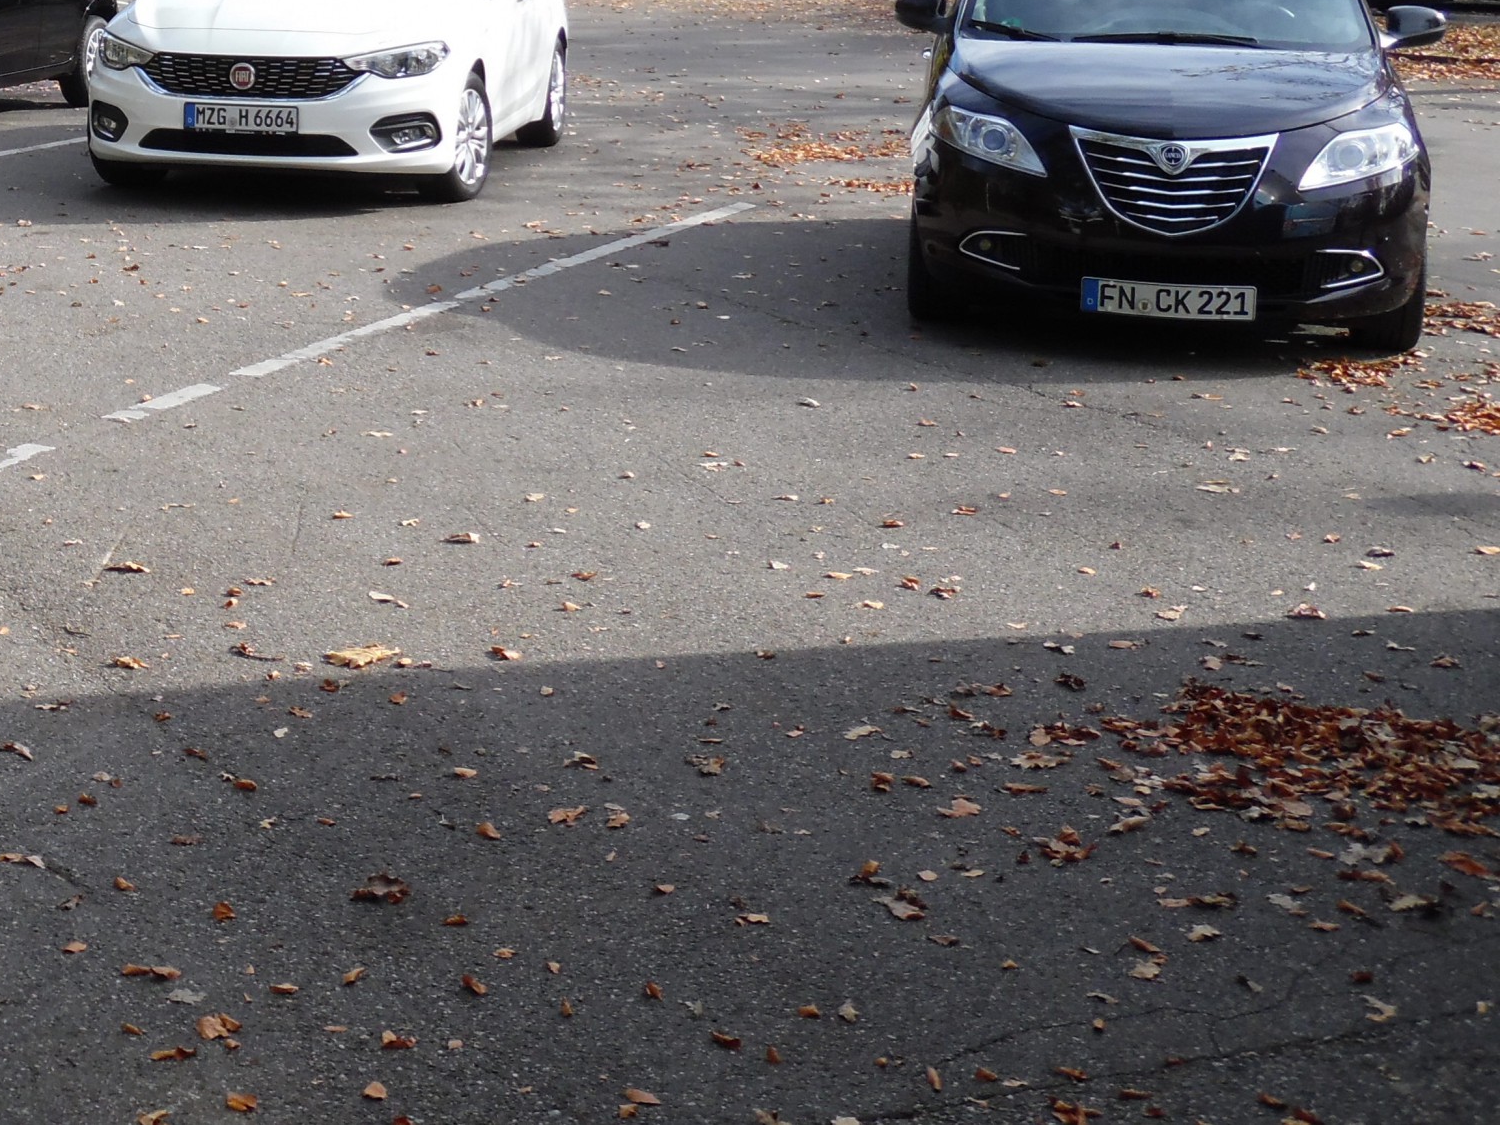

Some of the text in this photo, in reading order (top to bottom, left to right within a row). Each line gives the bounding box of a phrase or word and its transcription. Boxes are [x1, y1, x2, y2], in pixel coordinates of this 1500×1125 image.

[235, 70, 250, 83] FIAT
[196, 107, 227, 126] MZG
[238, 108, 249, 126] H
[253, 109, 295, 128] 6664
[1100, 283, 1136, 310] FN
[1155, 289, 1192, 314] CK
[1197, 290, 1249, 316] 221
